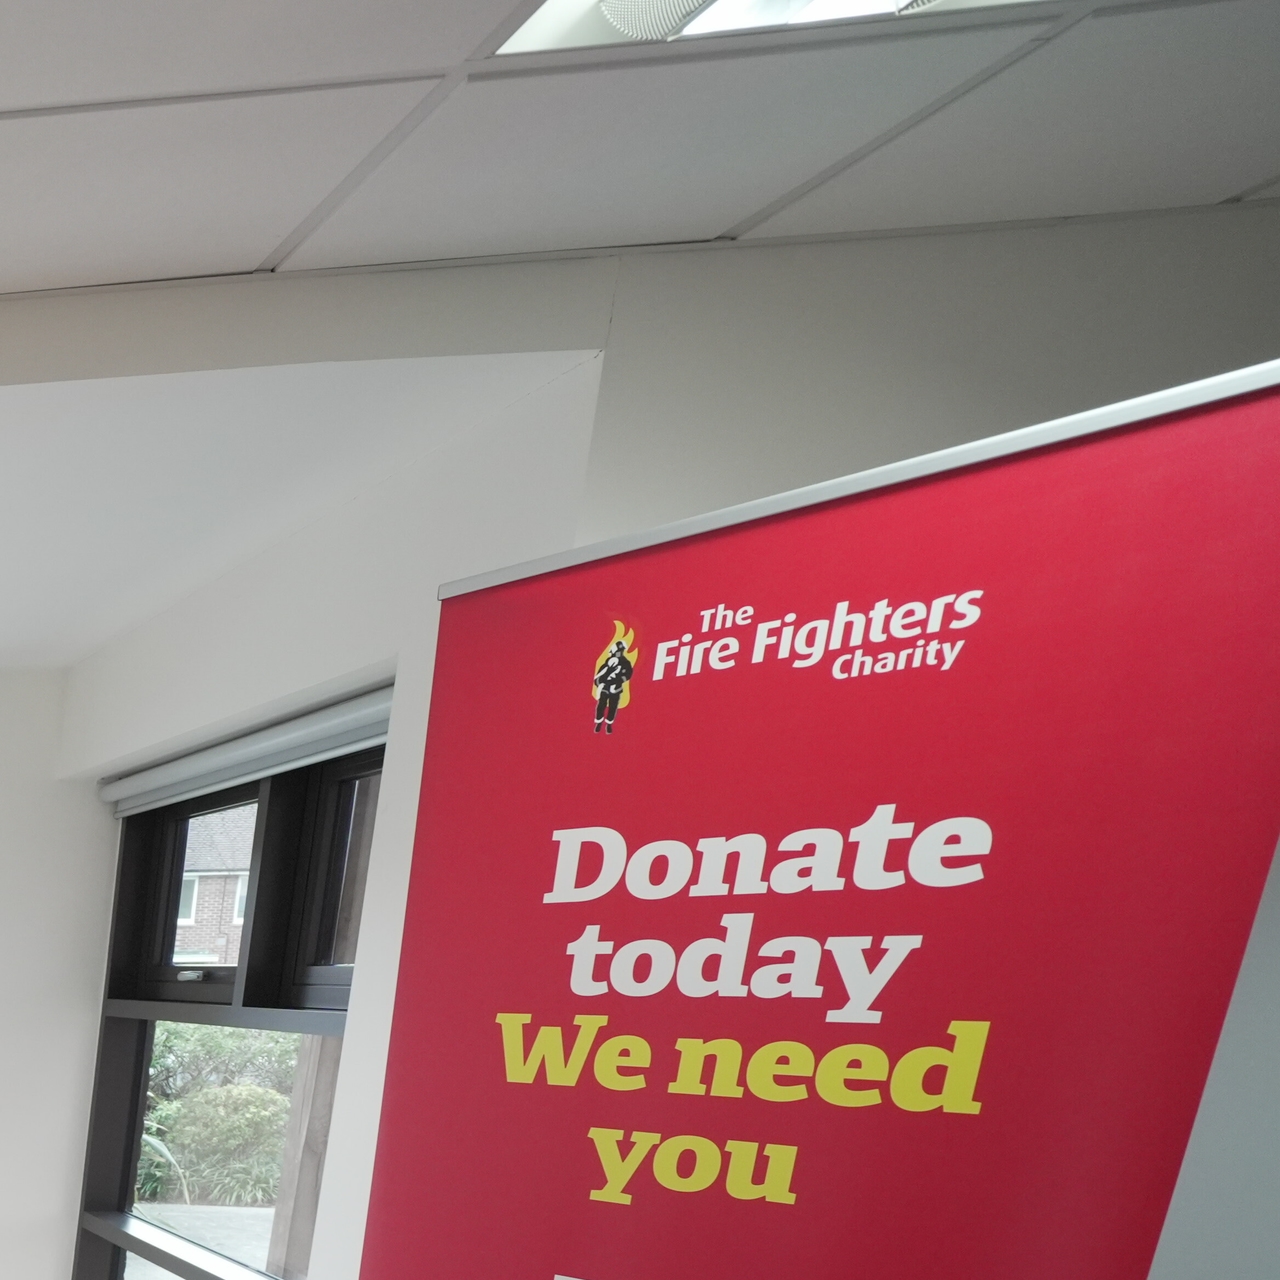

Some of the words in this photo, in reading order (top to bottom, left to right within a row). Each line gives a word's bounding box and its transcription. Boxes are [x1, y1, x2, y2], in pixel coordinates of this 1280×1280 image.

[652, 633, 739, 681] Fire
[751, 590, 984, 668] Fighters
[700, 604, 754, 633] The
[832, 639, 965, 680] Charity
[542, 803, 993, 904] Donate
[566, 912, 924, 1024] today
[495, 1013, 651, 1091] We
[667, 1020, 991, 1114] need
[587, 1127, 798, 1205] you
